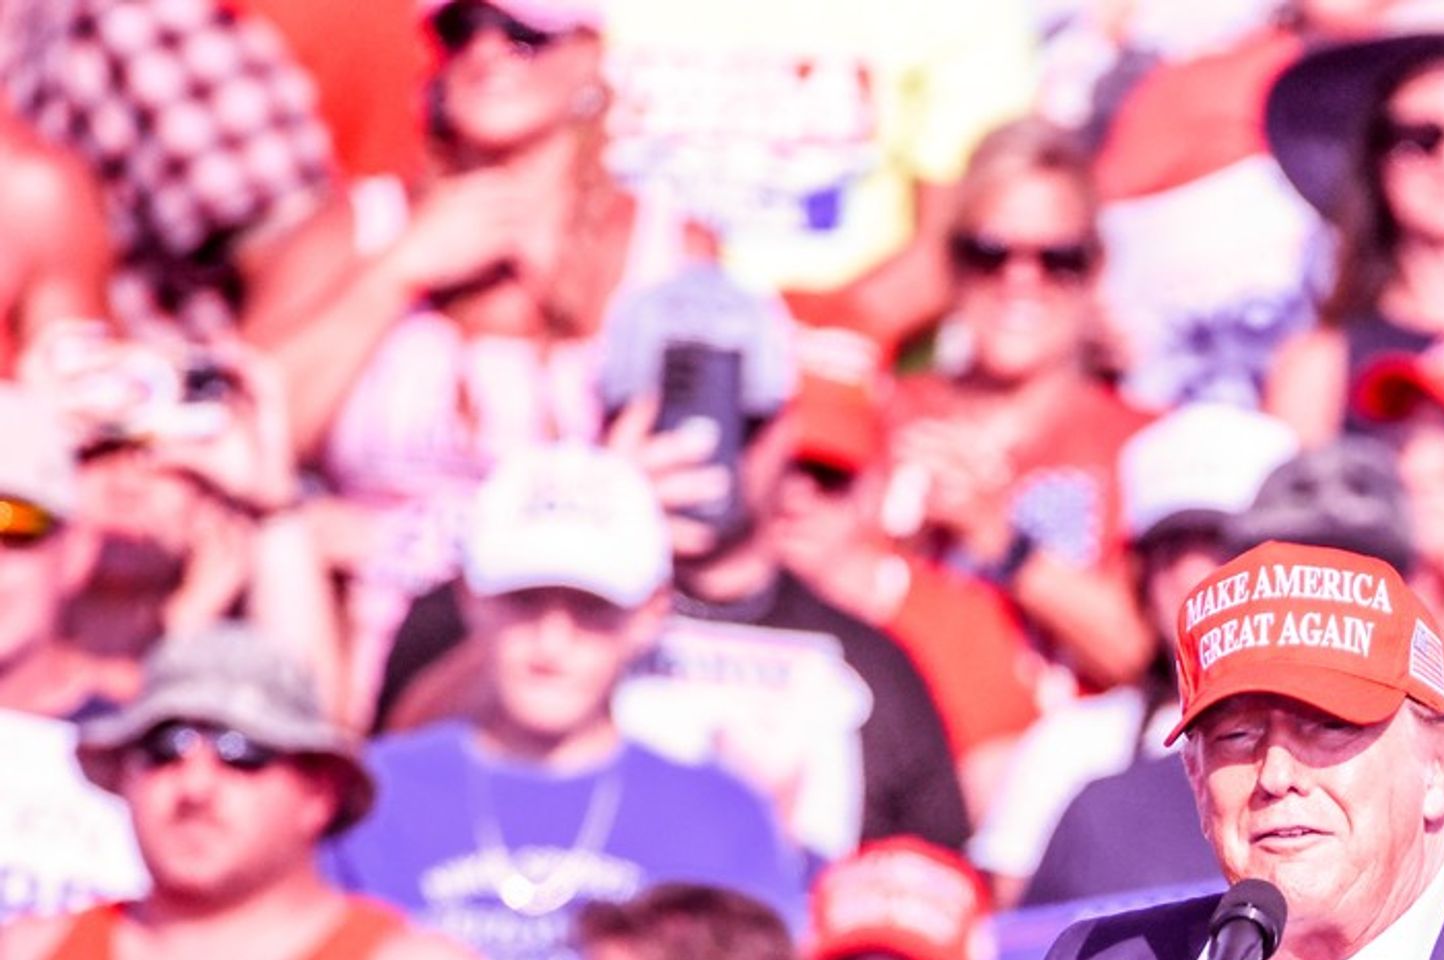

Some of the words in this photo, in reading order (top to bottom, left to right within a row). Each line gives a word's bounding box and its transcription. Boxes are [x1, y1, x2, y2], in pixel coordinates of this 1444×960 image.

[1186, 571, 1250, 631] MAKE
[1252, 564, 1393, 615] AMERICA
[1199, 612, 1275, 671] GREAT
[1277, 611, 1376, 658] AGAIN
